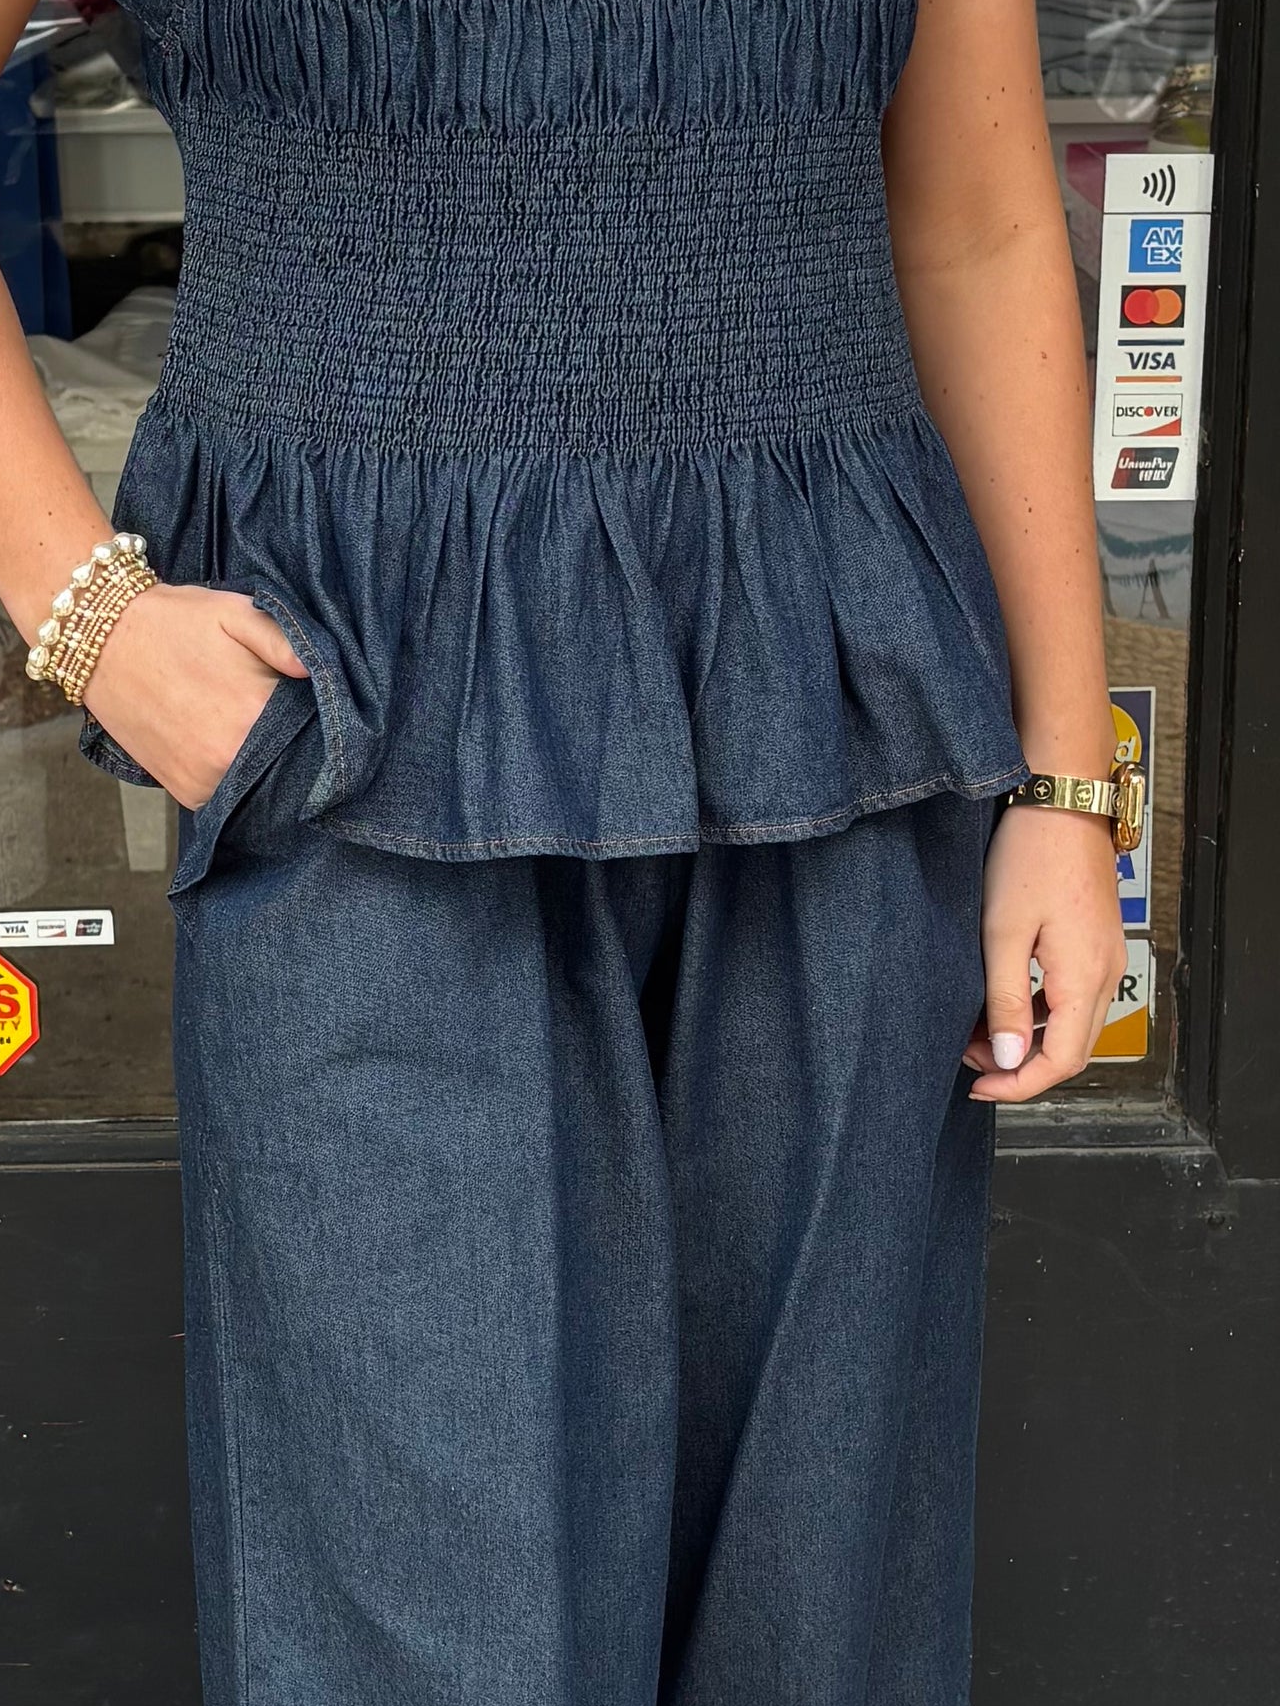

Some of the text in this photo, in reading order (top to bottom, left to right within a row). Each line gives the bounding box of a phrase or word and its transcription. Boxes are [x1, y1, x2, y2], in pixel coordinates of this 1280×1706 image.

[1144, 227, 1183, 247] AM
[1125, 351, 1177, 370] VISA
[1116, 405, 1179, 417] DISCOVER
